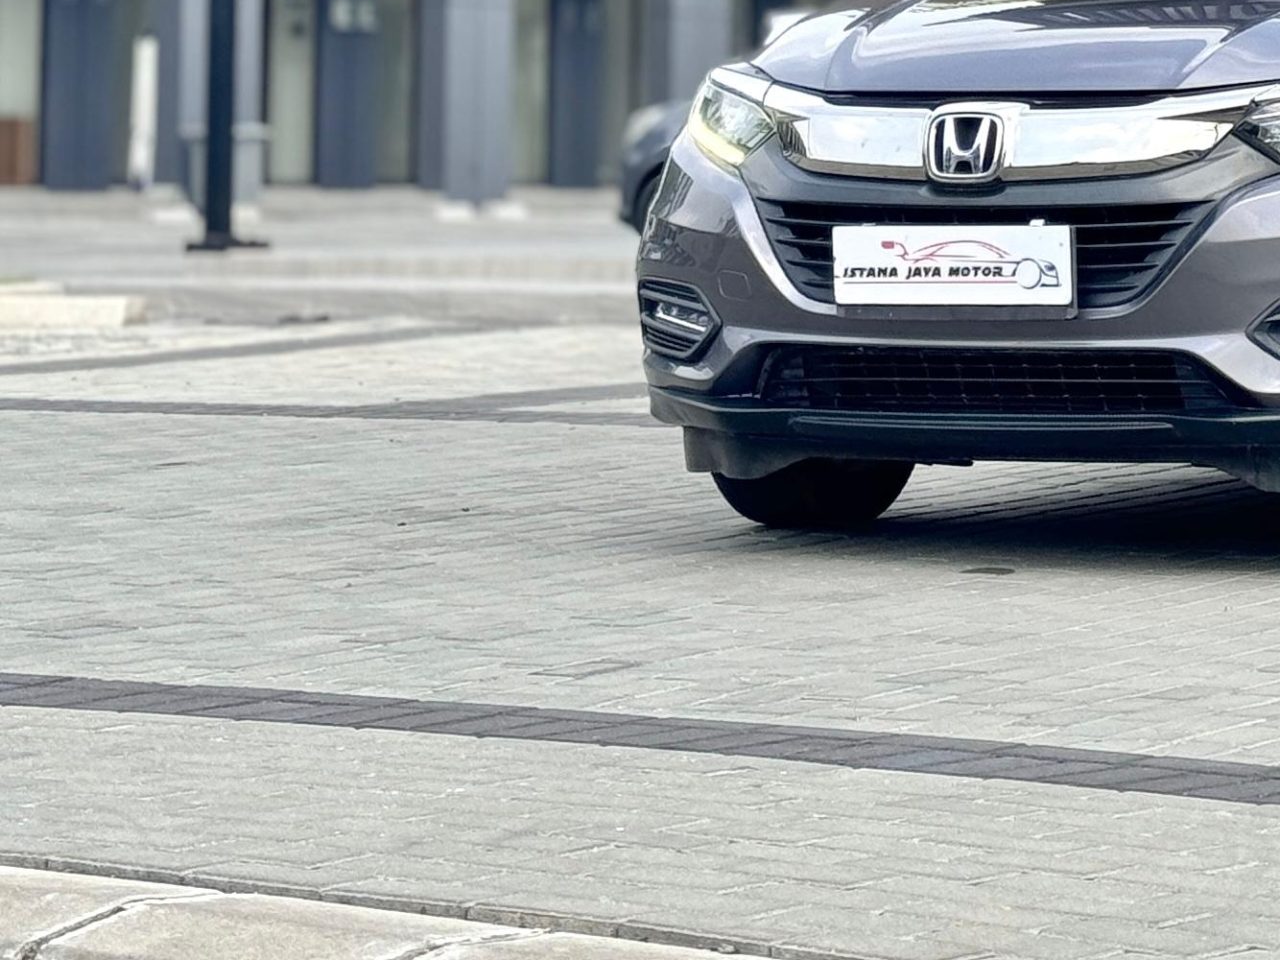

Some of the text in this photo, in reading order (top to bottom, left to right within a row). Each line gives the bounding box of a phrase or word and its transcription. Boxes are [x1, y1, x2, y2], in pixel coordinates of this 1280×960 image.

[842, 265, 1004, 281] ISTANA JAYA MOTOR
